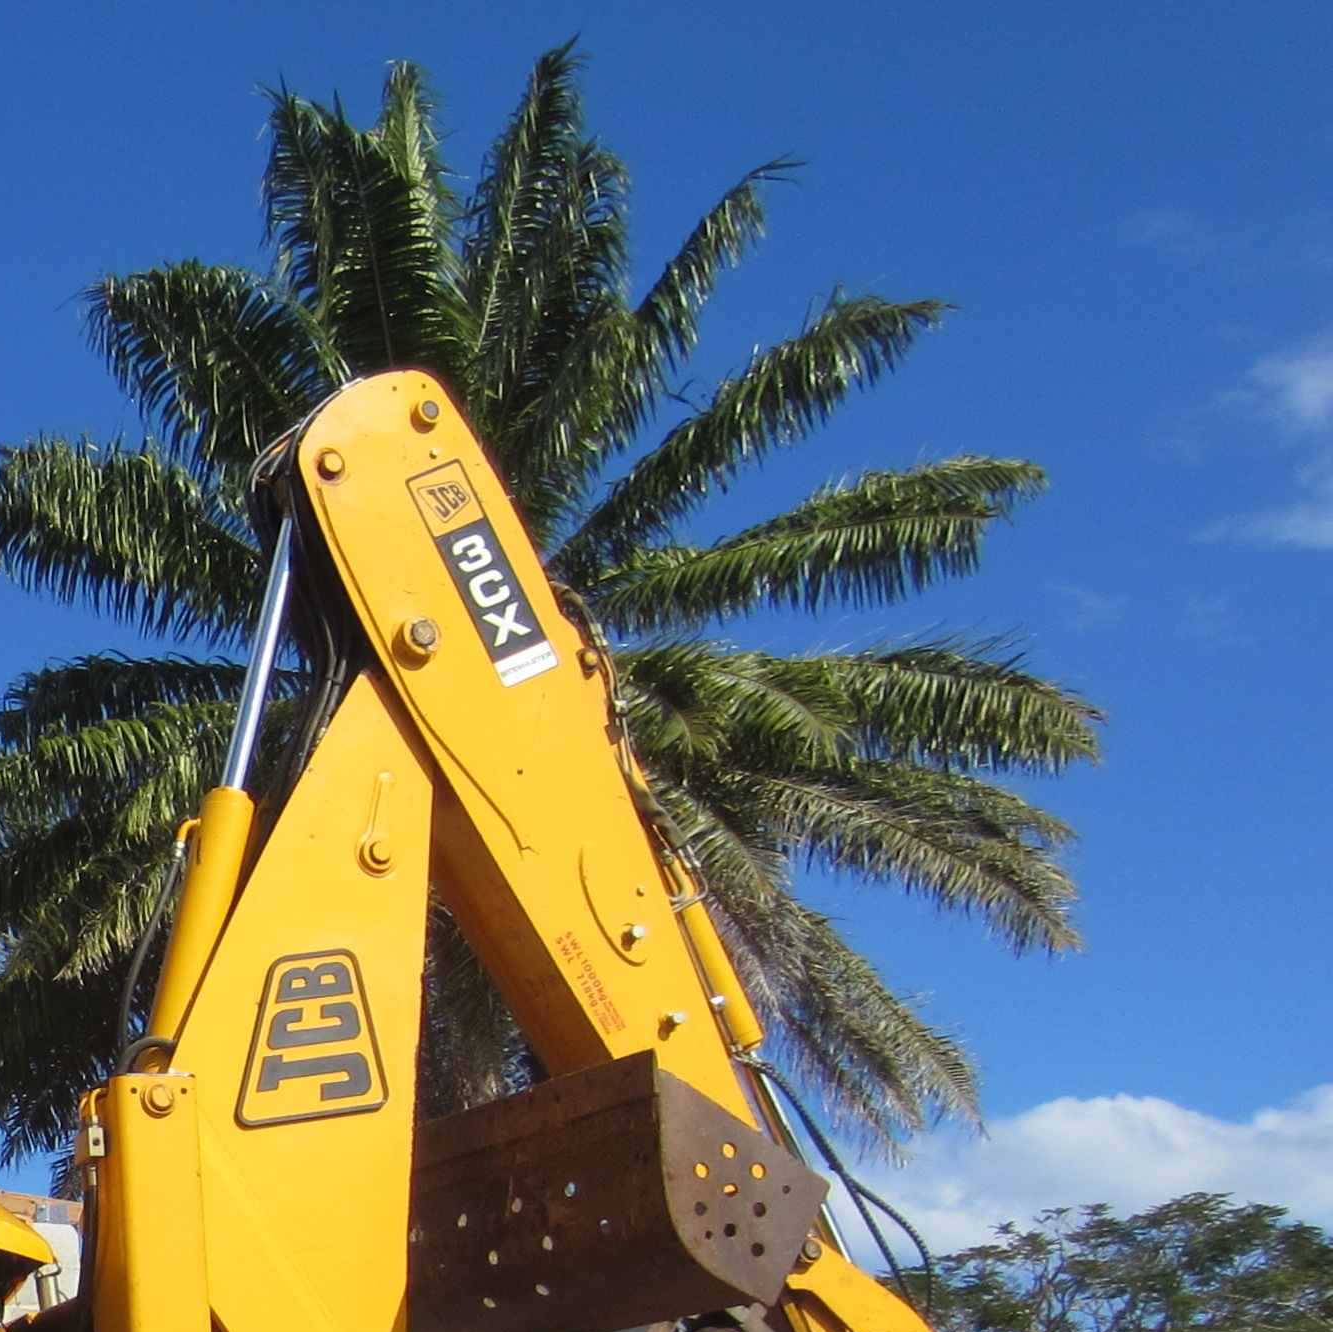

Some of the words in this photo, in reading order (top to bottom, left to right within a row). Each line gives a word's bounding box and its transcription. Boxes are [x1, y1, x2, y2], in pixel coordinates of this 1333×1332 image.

[425, 483, 467, 518] JCB
[452, 534, 532, 647] 3CX
[256, 962, 372, 1101] JCB
